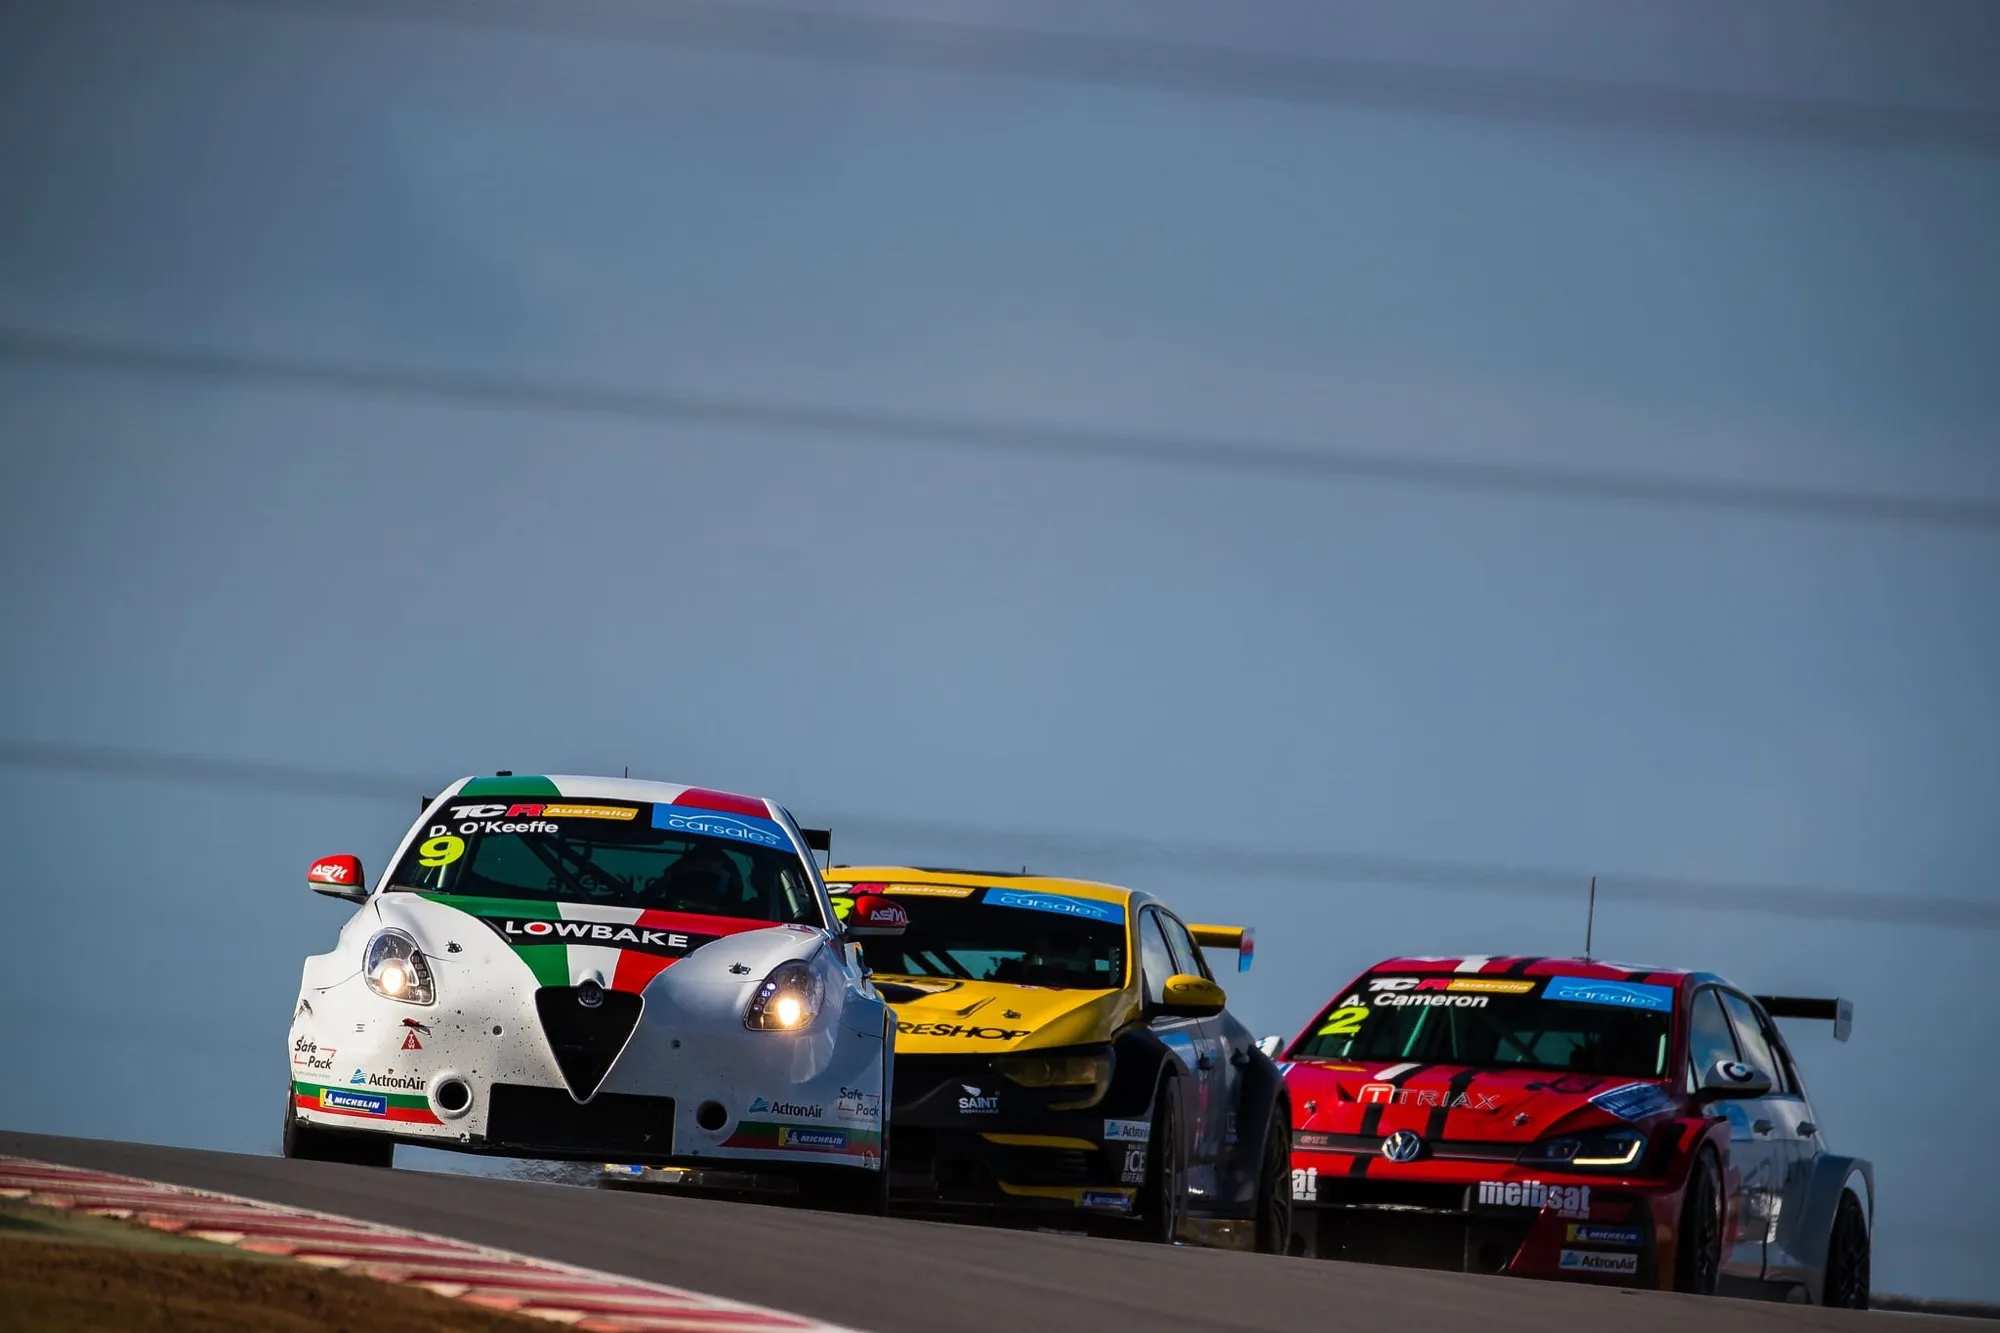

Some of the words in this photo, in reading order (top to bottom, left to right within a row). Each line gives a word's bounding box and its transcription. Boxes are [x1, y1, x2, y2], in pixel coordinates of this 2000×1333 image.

[450, 803, 545, 819] TCR
[548, 807, 633, 818] Australia
[429, 825, 451, 838] D.
[459, 821, 559, 834] O'Keeffe
[668, 817, 777, 845] carsales
[418, 836, 465, 867] 9
[825, 883, 888, 894] CR
[890, 885, 970, 896] Australia
[1000, 895, 1102, 917] carsales
[505, 921, 689, 948] LOWBAKE
[1369, 977, 1453, 991] TCR
[1455, 981, 1529, 991] Australia
[1340, 994, 1366, 1008] A.
[1374, 992, 1489, 1007] Cameron
[1559, 988, 1659, 1007] carsales
[1318, 1006, 1370, 1036] 2
[294, 1039, 317, 1053] Safe
[307, 1055, 332, 1070] Pack
[369, 1073, 427, 1091] ActronAir
[839, 1086, 864, 1101] Safe
[1395, 1088, 1501, 1109] TRIAX
[334, 1096, 380, 1109] MICHELIN
[771, 1101, 824, 1118] ActronAir
[855, 1103, 880, 1118] Pack
[959, 1097, 998, 1109] SAINT
[801, 1135, 843, 1144] MICHELIN
[1123, 1151, 1145, 1172] ICE
[1479, 1179, 1591, 1210] melbsat
[1590, 1230, 1638, 1240] MICHELIN
[1582, 1255, 1636, 1270] ActronAir
